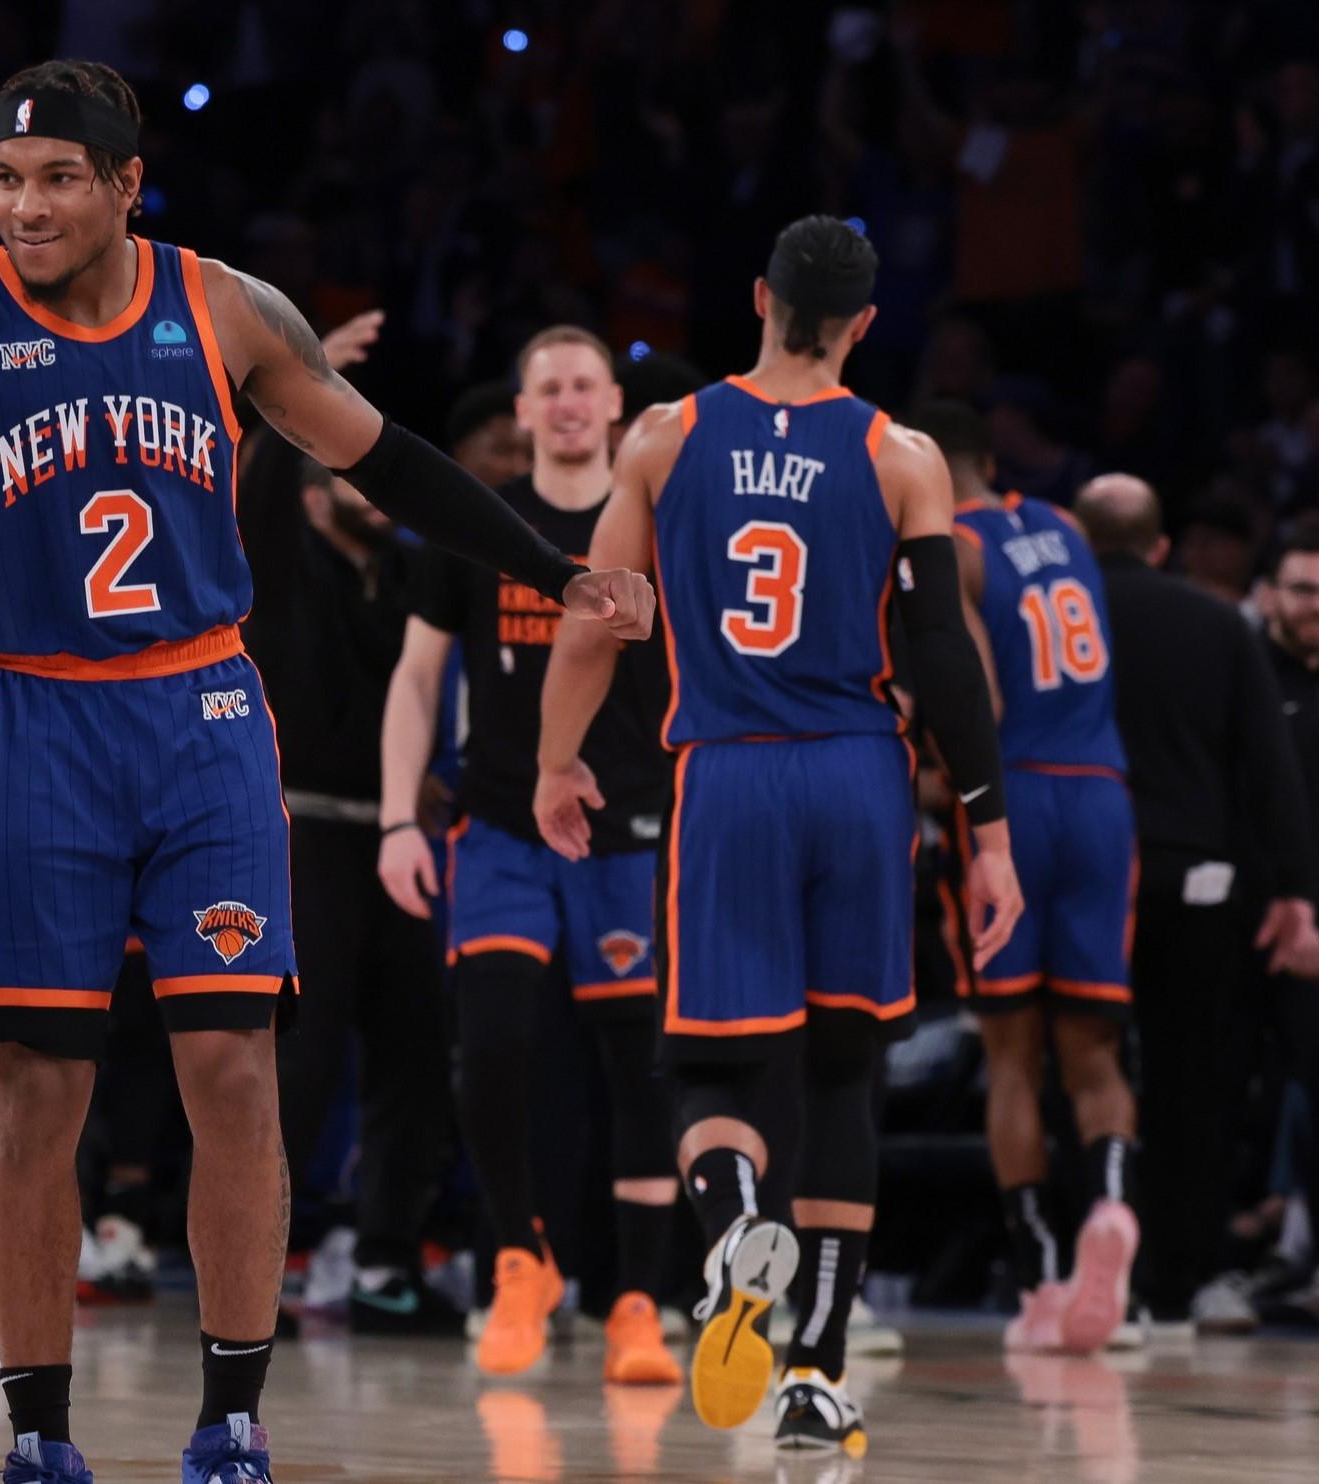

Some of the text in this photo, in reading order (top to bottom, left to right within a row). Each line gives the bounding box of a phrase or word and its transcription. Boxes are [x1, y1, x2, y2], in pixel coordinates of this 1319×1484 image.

[0, 338, 56, 370] NYC
[151, 346, 194, 360] sphere
[103, 395, 217, 480] YORK
[731, 449, 825, 503] HART
[79, 489, 161, 619] 2
[720, 520, 808, 658] 3
[1017, 577, 1110, 692] 18
[201, 688, 250, 720] NYC
[199, 908, 261, 938] KNICKS
